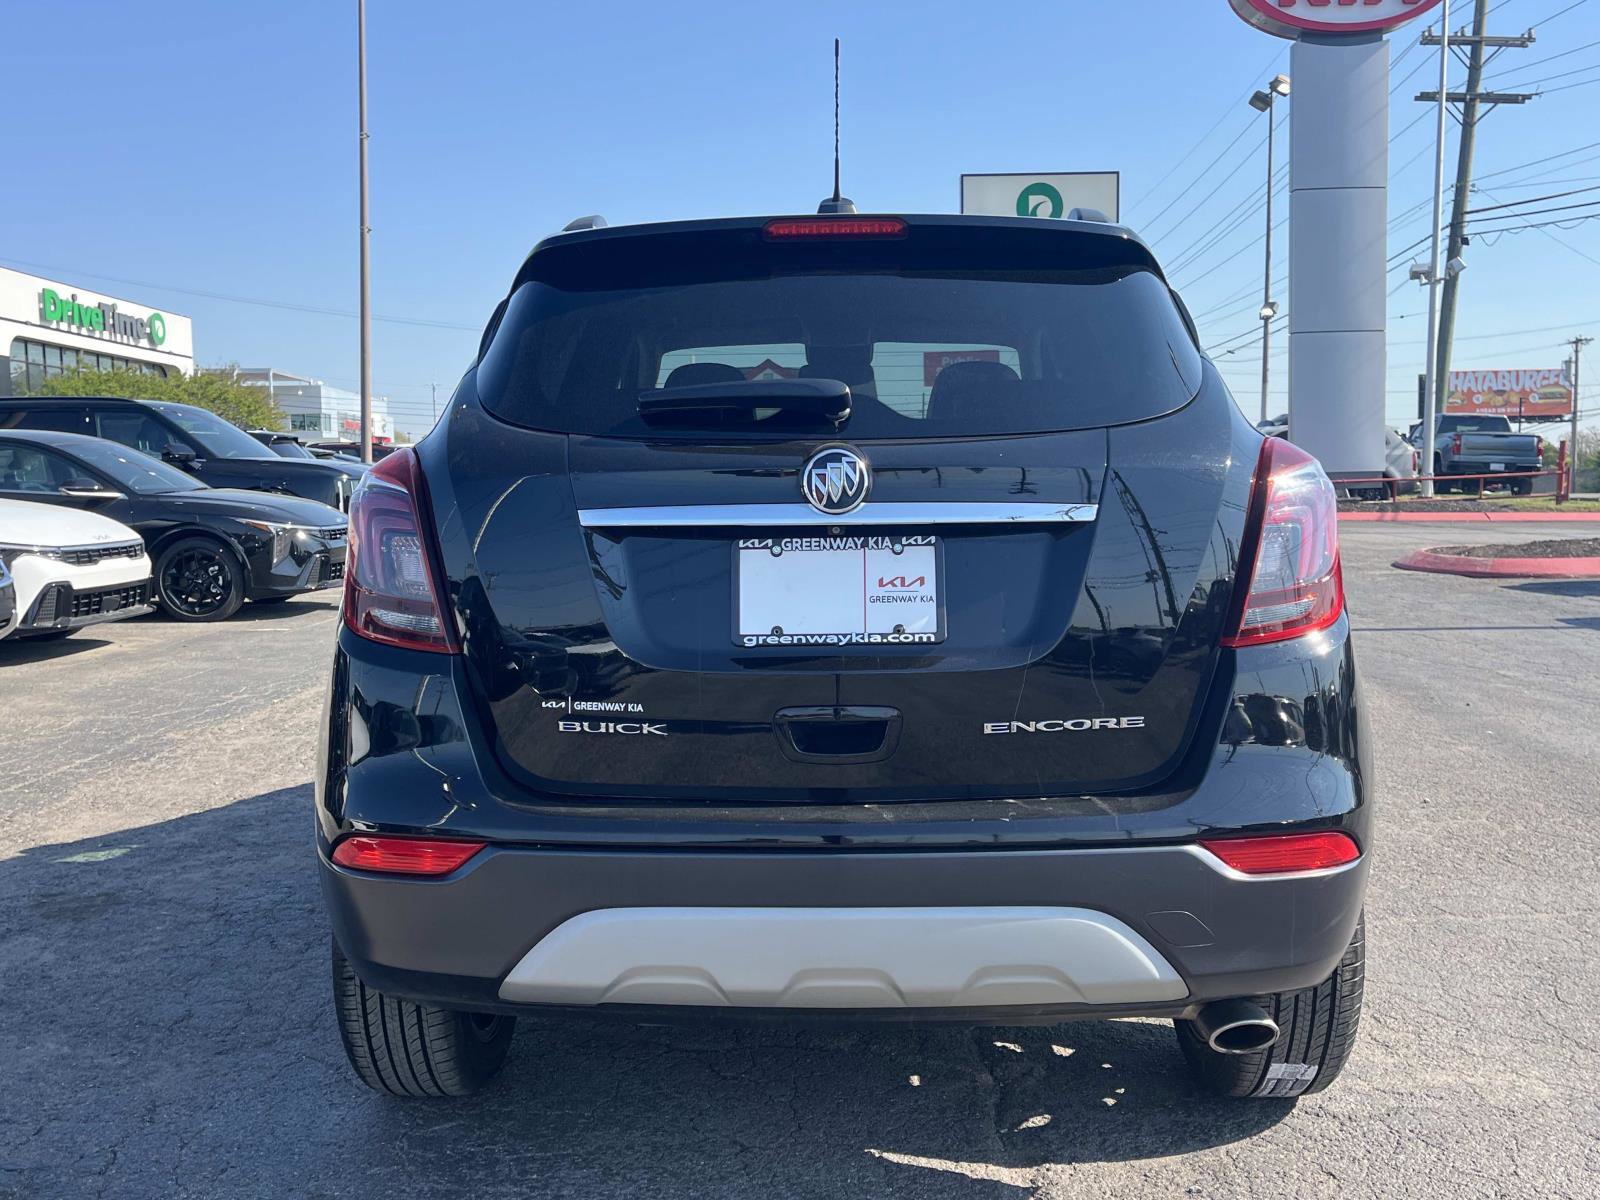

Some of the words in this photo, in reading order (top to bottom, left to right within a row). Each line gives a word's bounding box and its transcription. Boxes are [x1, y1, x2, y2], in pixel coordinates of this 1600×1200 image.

[42, 288, 147, 340] DriveTime
[781, 537, 864, 551] GREENWAY
[868, 536, 893, 550] KIA
[869, 595, 918, 604] GREENWAY
[920, 595, 935, 603] KIA
[743, 631, 936, 647] greenwaykia.com
[574, 701, 626, 712] GREENWAY
[628, 703, 644, 713] KIA
[557, 720, 669, 736] BUICK
[983, 716, 1146, 735] ENCORE
